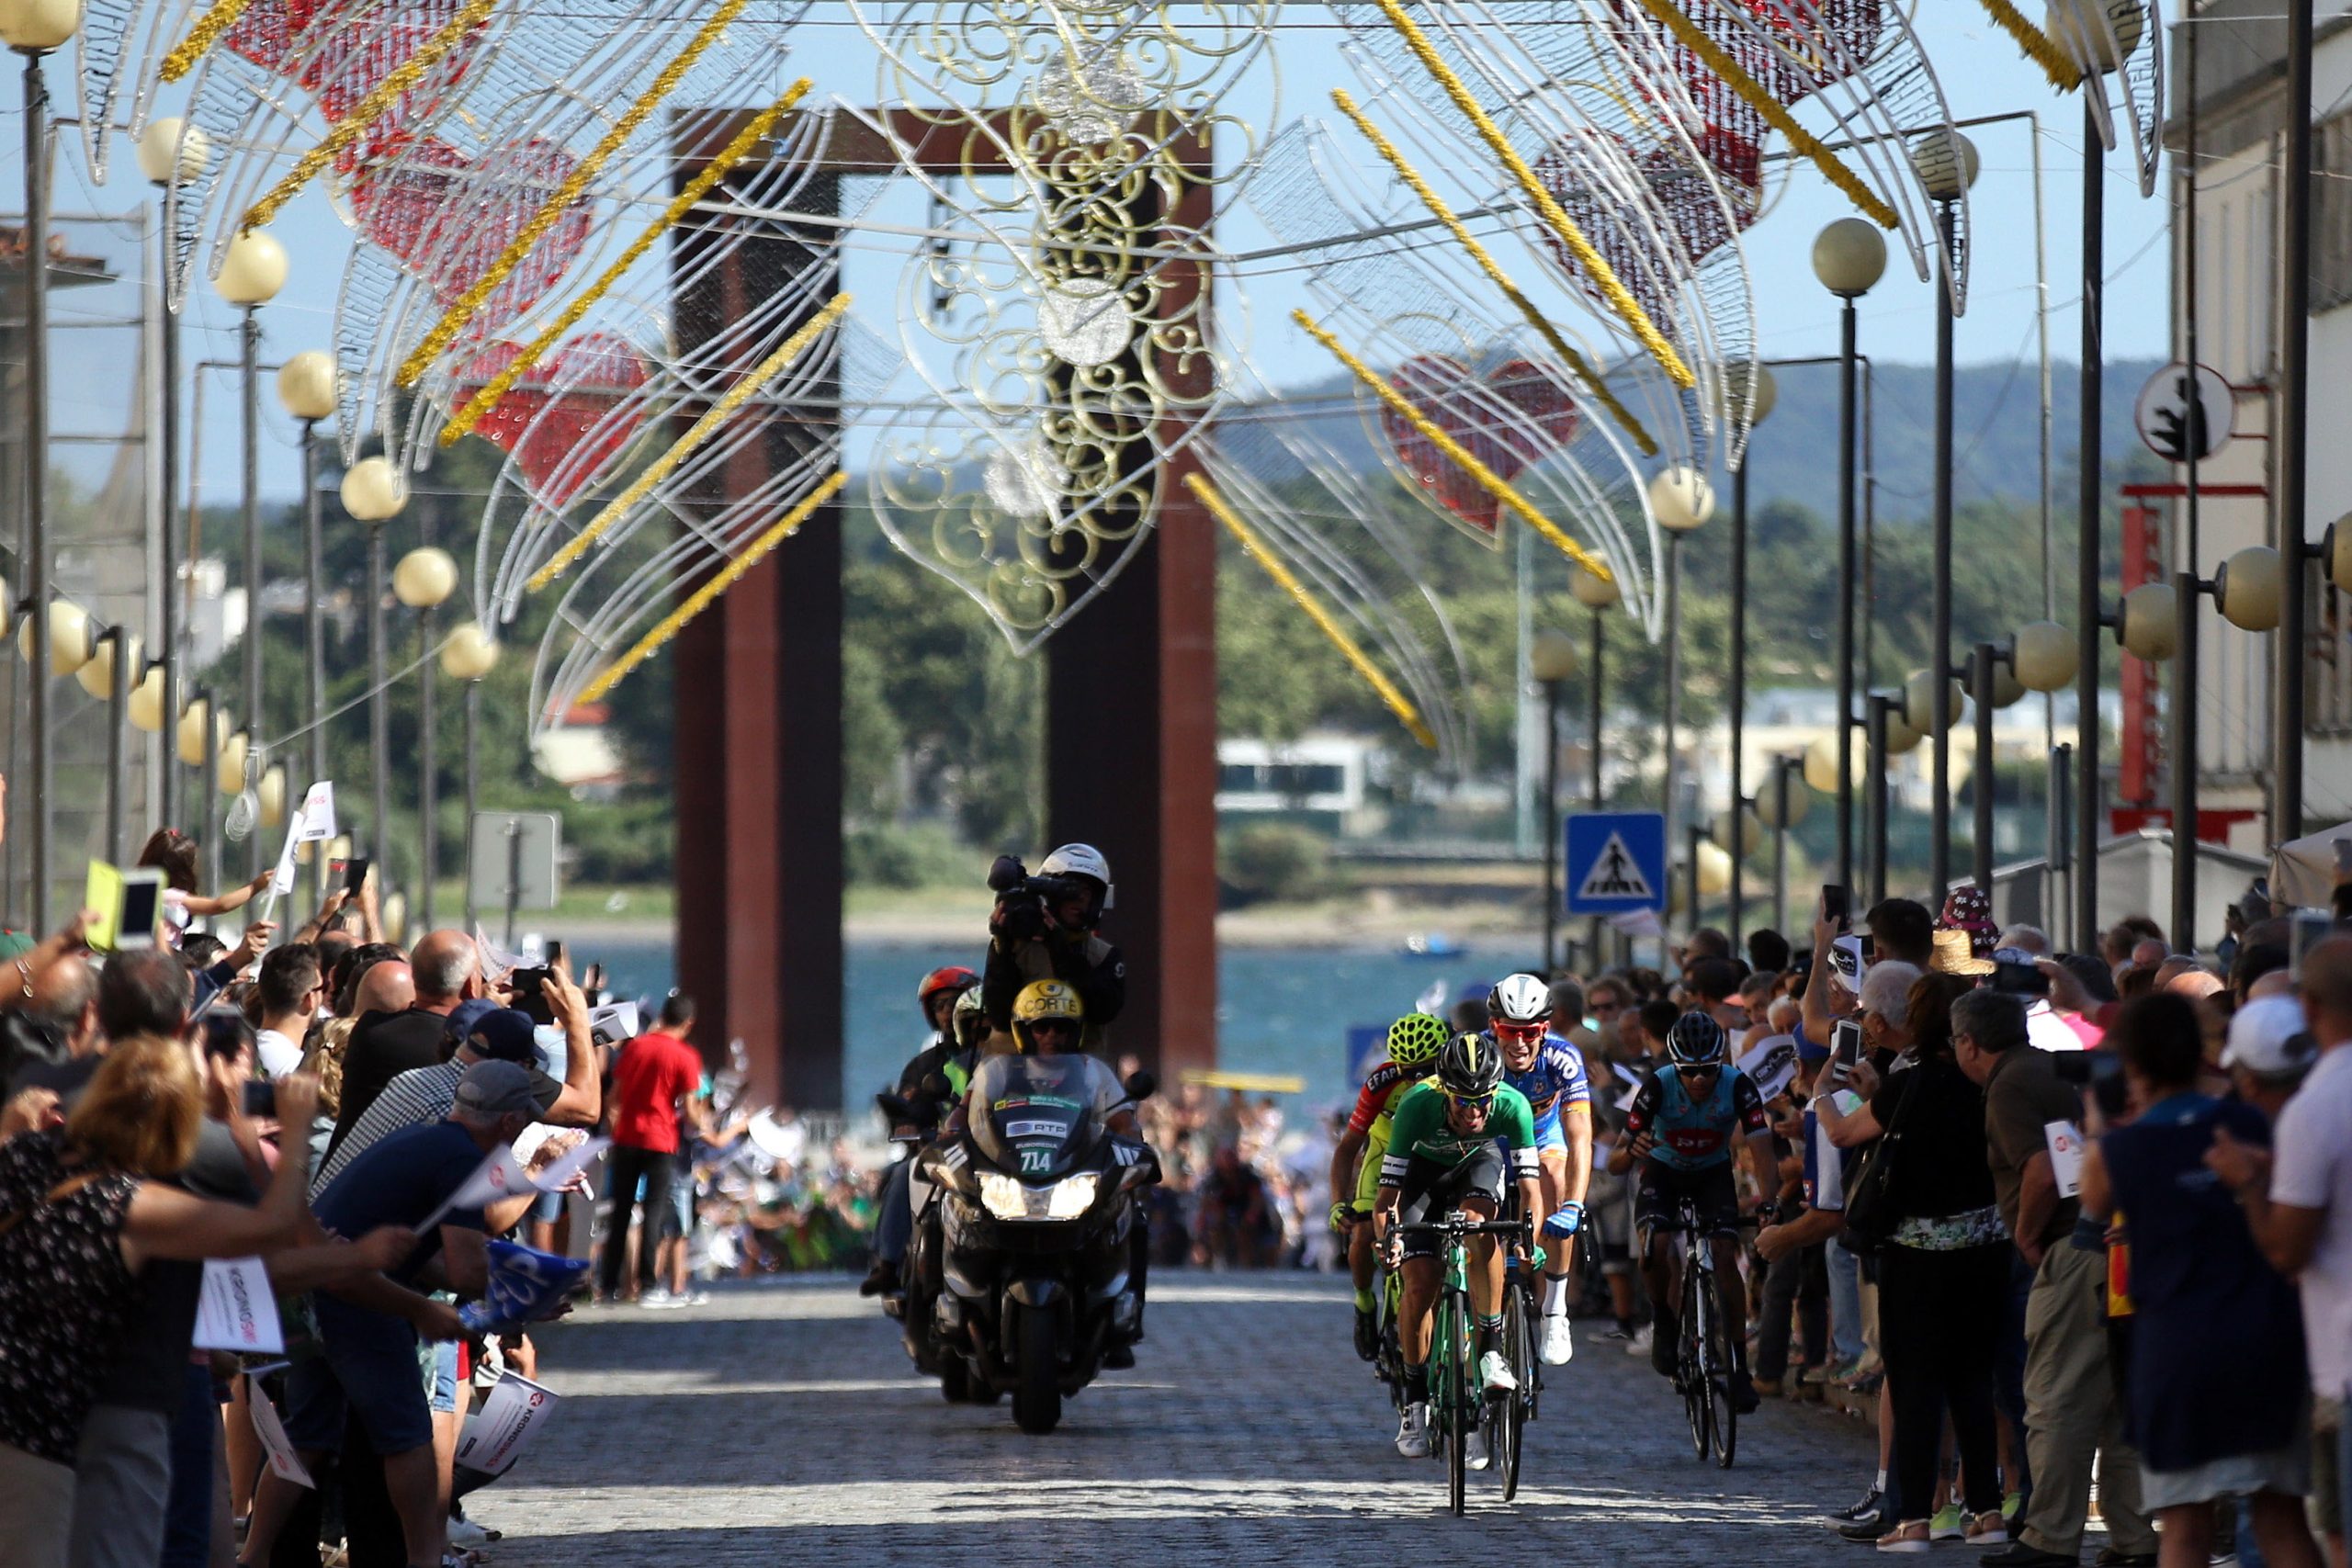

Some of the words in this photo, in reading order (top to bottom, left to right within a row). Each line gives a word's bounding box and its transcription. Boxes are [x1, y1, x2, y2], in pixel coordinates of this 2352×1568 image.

[1023, 998, 1077, 1013] CORTE
[1034, 1123, 1066, 1133] RTP
[1020, 1151, 1051, 1172] 714
